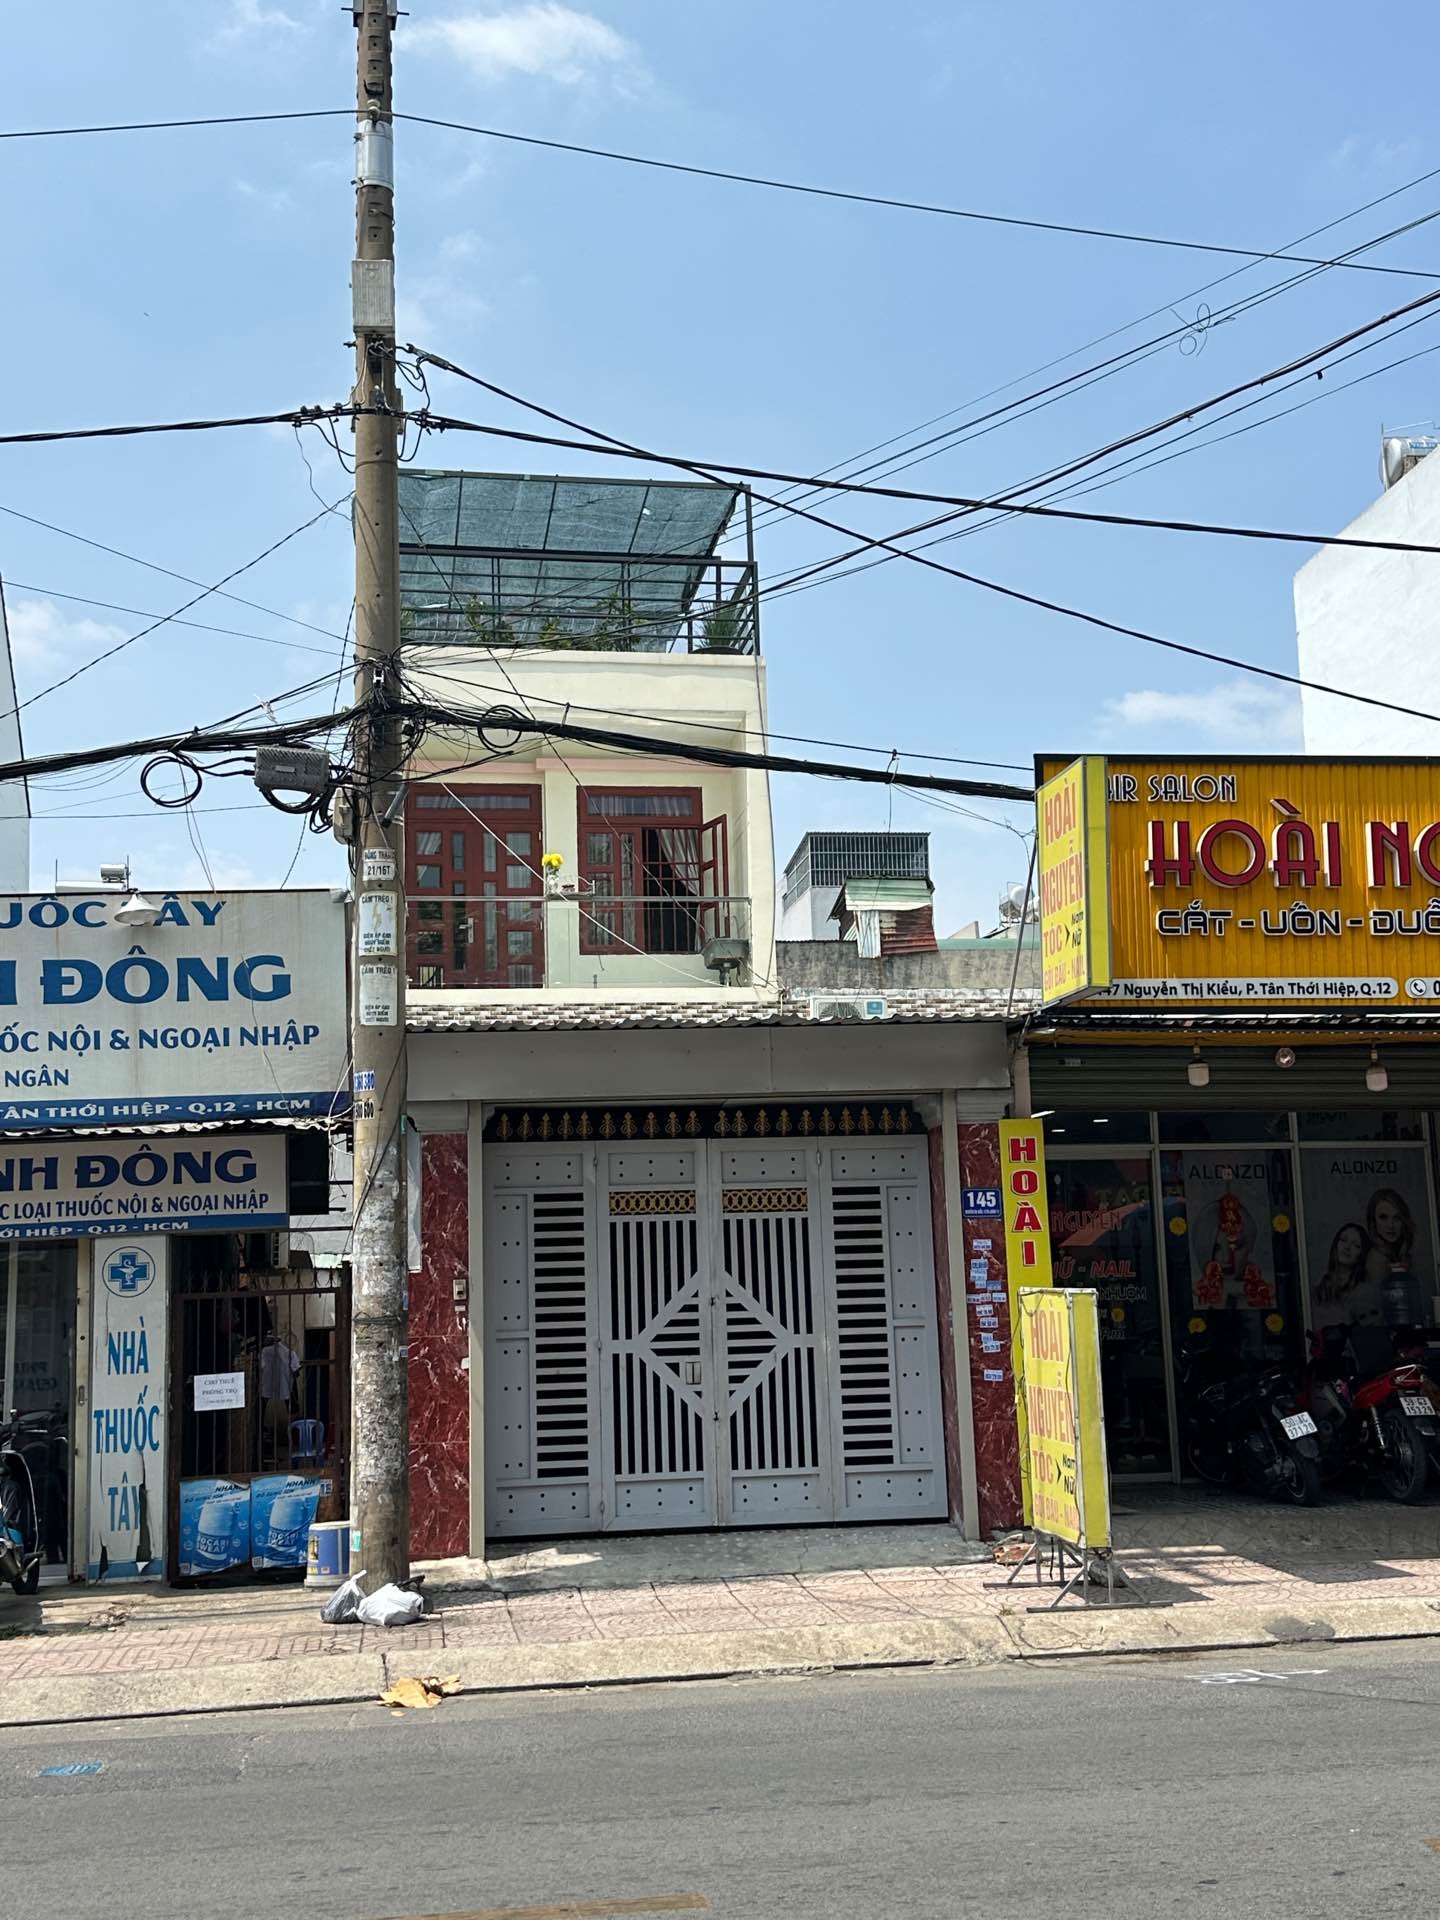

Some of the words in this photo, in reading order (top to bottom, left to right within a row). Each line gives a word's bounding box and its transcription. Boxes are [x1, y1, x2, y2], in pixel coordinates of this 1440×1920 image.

[1148, 774, 1237, 802] SALON
[1044, 777, 1077, 846] HOÀI
[1144, 799, 1342, 888] HOÀI
[1041, 839, 1083, 918] NGUYỄN
[1156, 899, 1234, 936] CẮT
[1261, 901, 1341, 935] UỐN
[1044, 924, 1063, 958] TÓC
[40, 945, 291, 1005] ĐÔNG
[1123, 980, 1178, 998] Nguyễn
[1182, 982, 1204, 998] Thị
[1288, 981, 1320, 995] Thới
[48, 1024, 101, 1057] NỘI
[109, 1029, 130, 1050] &
[138, 1027, 230, 1053] NGOẠI
[240, 1019, 320, 1051] NHẬP
[4, 1064, 70, 1087] NGÂN
[46, 1103, 105, 1118] THỚI
[112, 1101, 170, 1117] HIỆP
[188, 1101, 236, 1115] Q.12
[256, 1099, 311, 1111] HCM
[75, 1144, 257, 1188] ĐÔNG
[1189, 1164, 1266, 1180] ALONZO
[1331, 1160, 1398, 1174] ALONZO
[14, 1201, 50, 1222] LOẠI
[57, 1192, 113, 1217] THUỐC
[117, 1194, 147, 1218] NỘI
[152, 1197, 163, 1212] &
[168, 1193, 219, 1215] NGOẠI
[223, 1189, 269, 1213] NHẬP
[967, 1192, 997, 1208] 145
[25, 1226, 73, 1238] HIỆP
[88, 1223, 127, 1235] Q.12
[143, 1221, 189, 1231] HCM
[1089, 1260, 1137, 1278] NAIL
[108, 1316, 149, 1376] NHÀ
[1031, 1300, 1064, 1362] HOÀI
[93, 1385, 160, 1455] THUỐC
